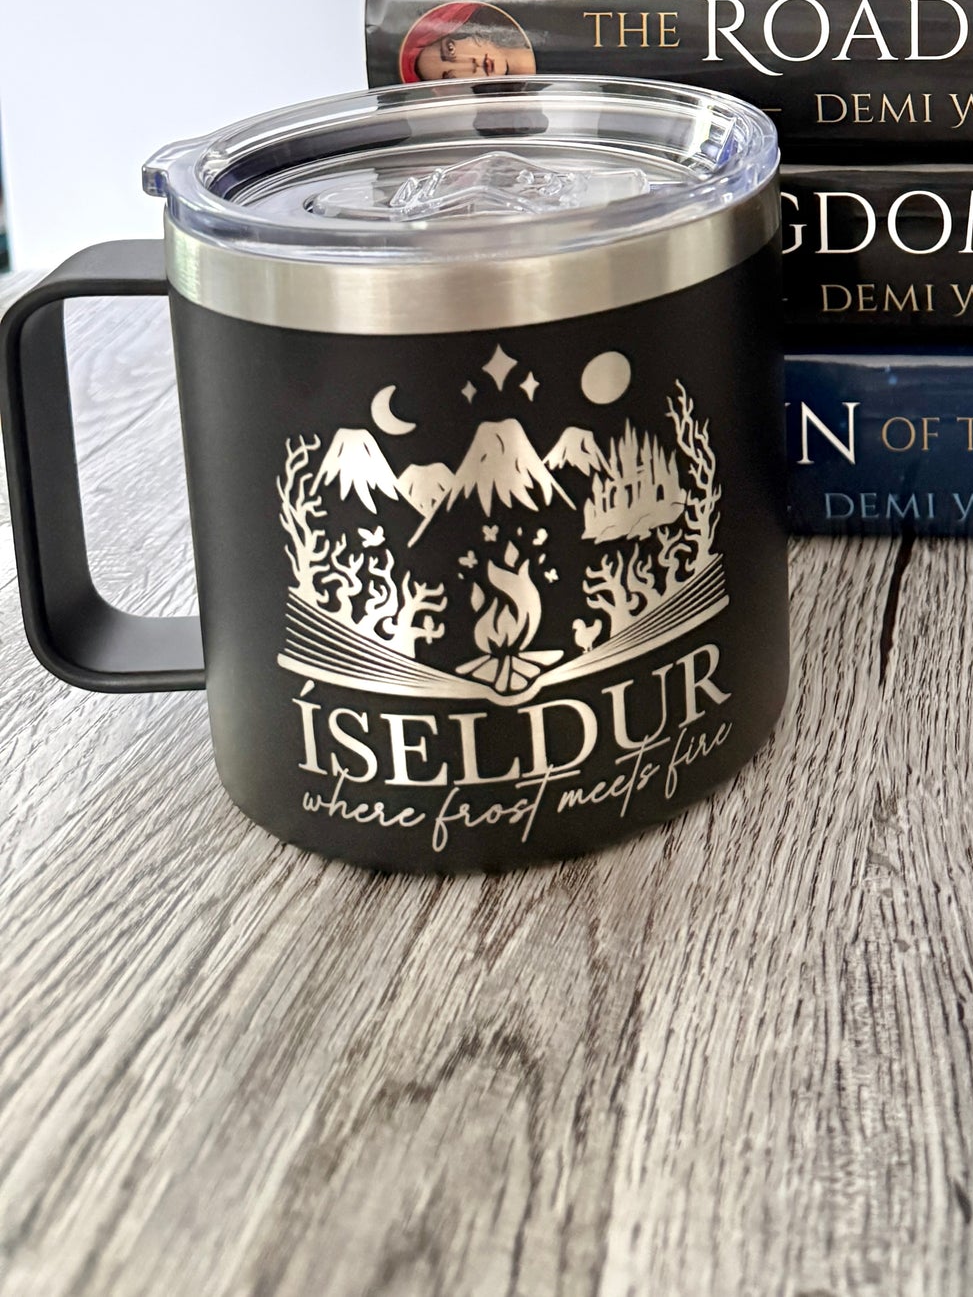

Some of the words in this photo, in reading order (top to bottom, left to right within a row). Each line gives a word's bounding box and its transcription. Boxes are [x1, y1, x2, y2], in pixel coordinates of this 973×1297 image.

[582, 11, 680, 48] THE
[815, 93, 932, 123] DEMI
[821, 283, 934, 312] DEMI
[784, 401, 861, 465] N
[881, 416, 940, 451] OF
[824, 492, 935, 520] DEMI
[291, 642, 732, 788] ÍSELDUR
[302, 767, 427, 828] where
[431, 763, 581, 853] frost
[556, 734, 672, 818] meets
[664, 721, 733, 800] fire
